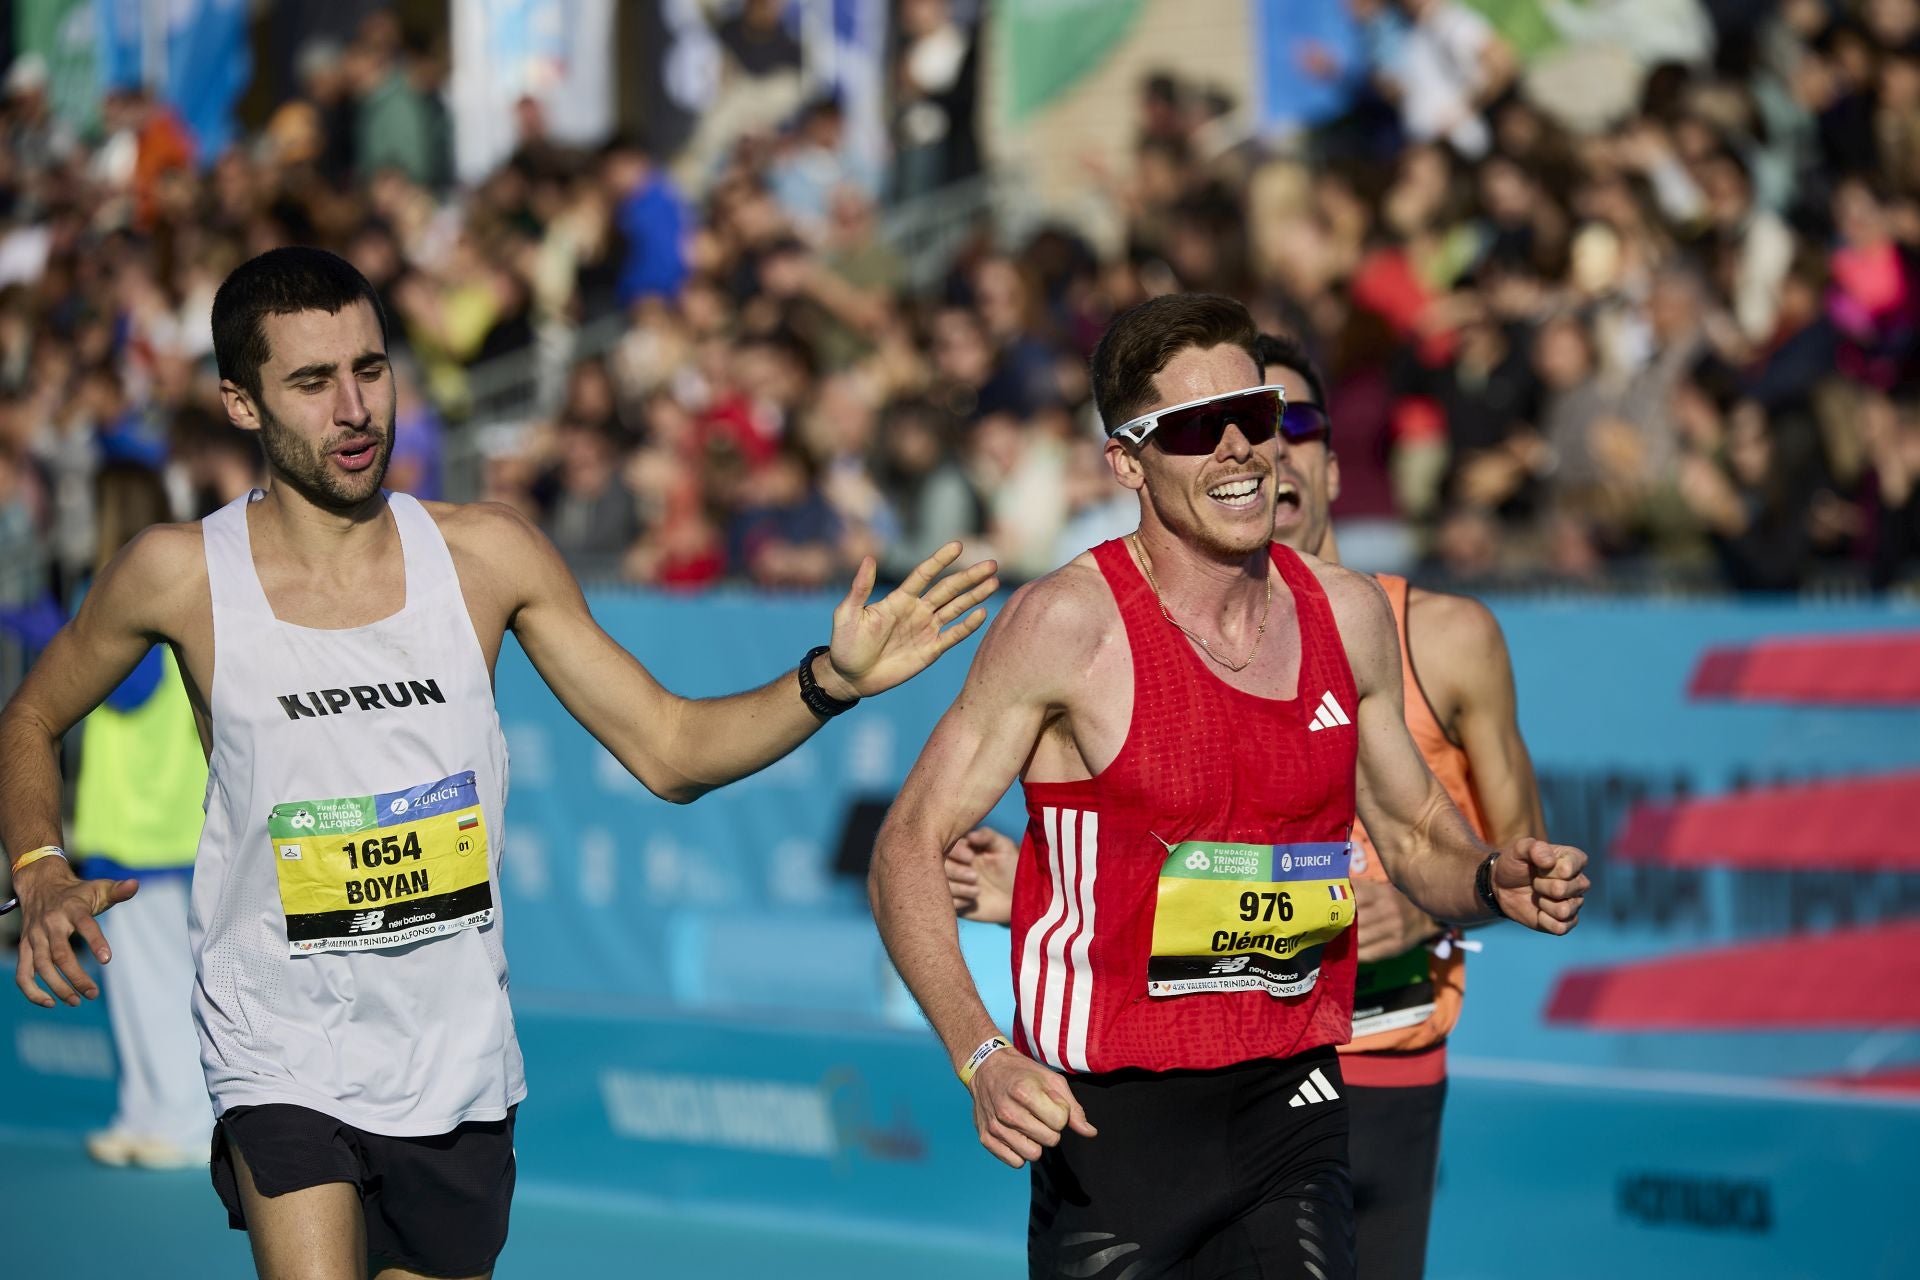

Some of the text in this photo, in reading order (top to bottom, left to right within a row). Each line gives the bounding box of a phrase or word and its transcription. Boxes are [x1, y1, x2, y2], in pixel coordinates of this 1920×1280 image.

[276, 678, 446, 720] KIPRUN
[414, 787, 458, 807] ZURICH
[317, 810, 362, 820] TRINIDAD
[319, 819, 363, 829] ALFONSO
[342, 831, 422, 869] 1654
[459, 840, 469, 851] 01
[1213, 855, 1259, 866] TRINIDAD
[1294, 855, 1331, 867] ZURICH
[1212, 865, 1258, 875] ALFONSO
[345, 868, 429, 905] BOYAN
[1239, 891, 1294, 922] 976
[388, 912, 436, 929] new balance
[1330, 911, 1339, 921] 01
[328, 939, 358, 948] VALENCIA
[359, 935, 400, 946] TRINIDAD
[401, 926, 437, 941] ALFONSO
[1248, 966, 1267, 975] new
[1187, 982, 1217, 990] VALENCIA
[1219, 979, 1257, 989] TRINIDAD
[1257, 980, 1296, 993] ALFONSO
